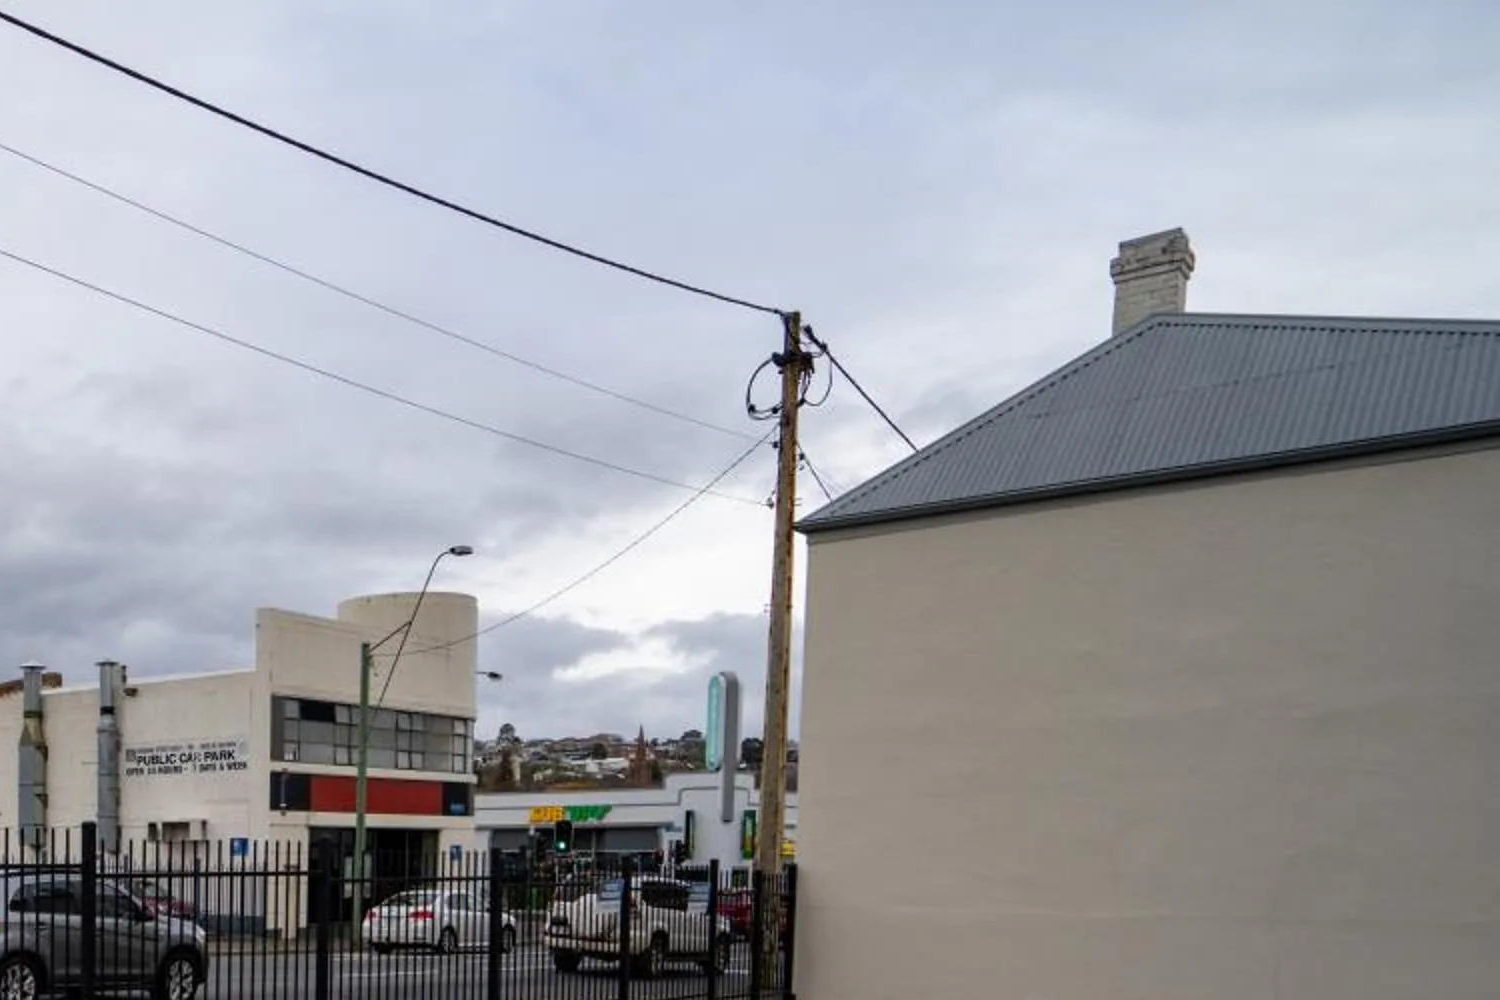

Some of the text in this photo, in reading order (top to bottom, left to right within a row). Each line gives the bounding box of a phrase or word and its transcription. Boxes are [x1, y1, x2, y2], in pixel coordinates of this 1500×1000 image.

[137, 753, 177, 766] PUBLIC
[179, 751, 202, 764] CAR
[204, 749, 236, 761] PARK
